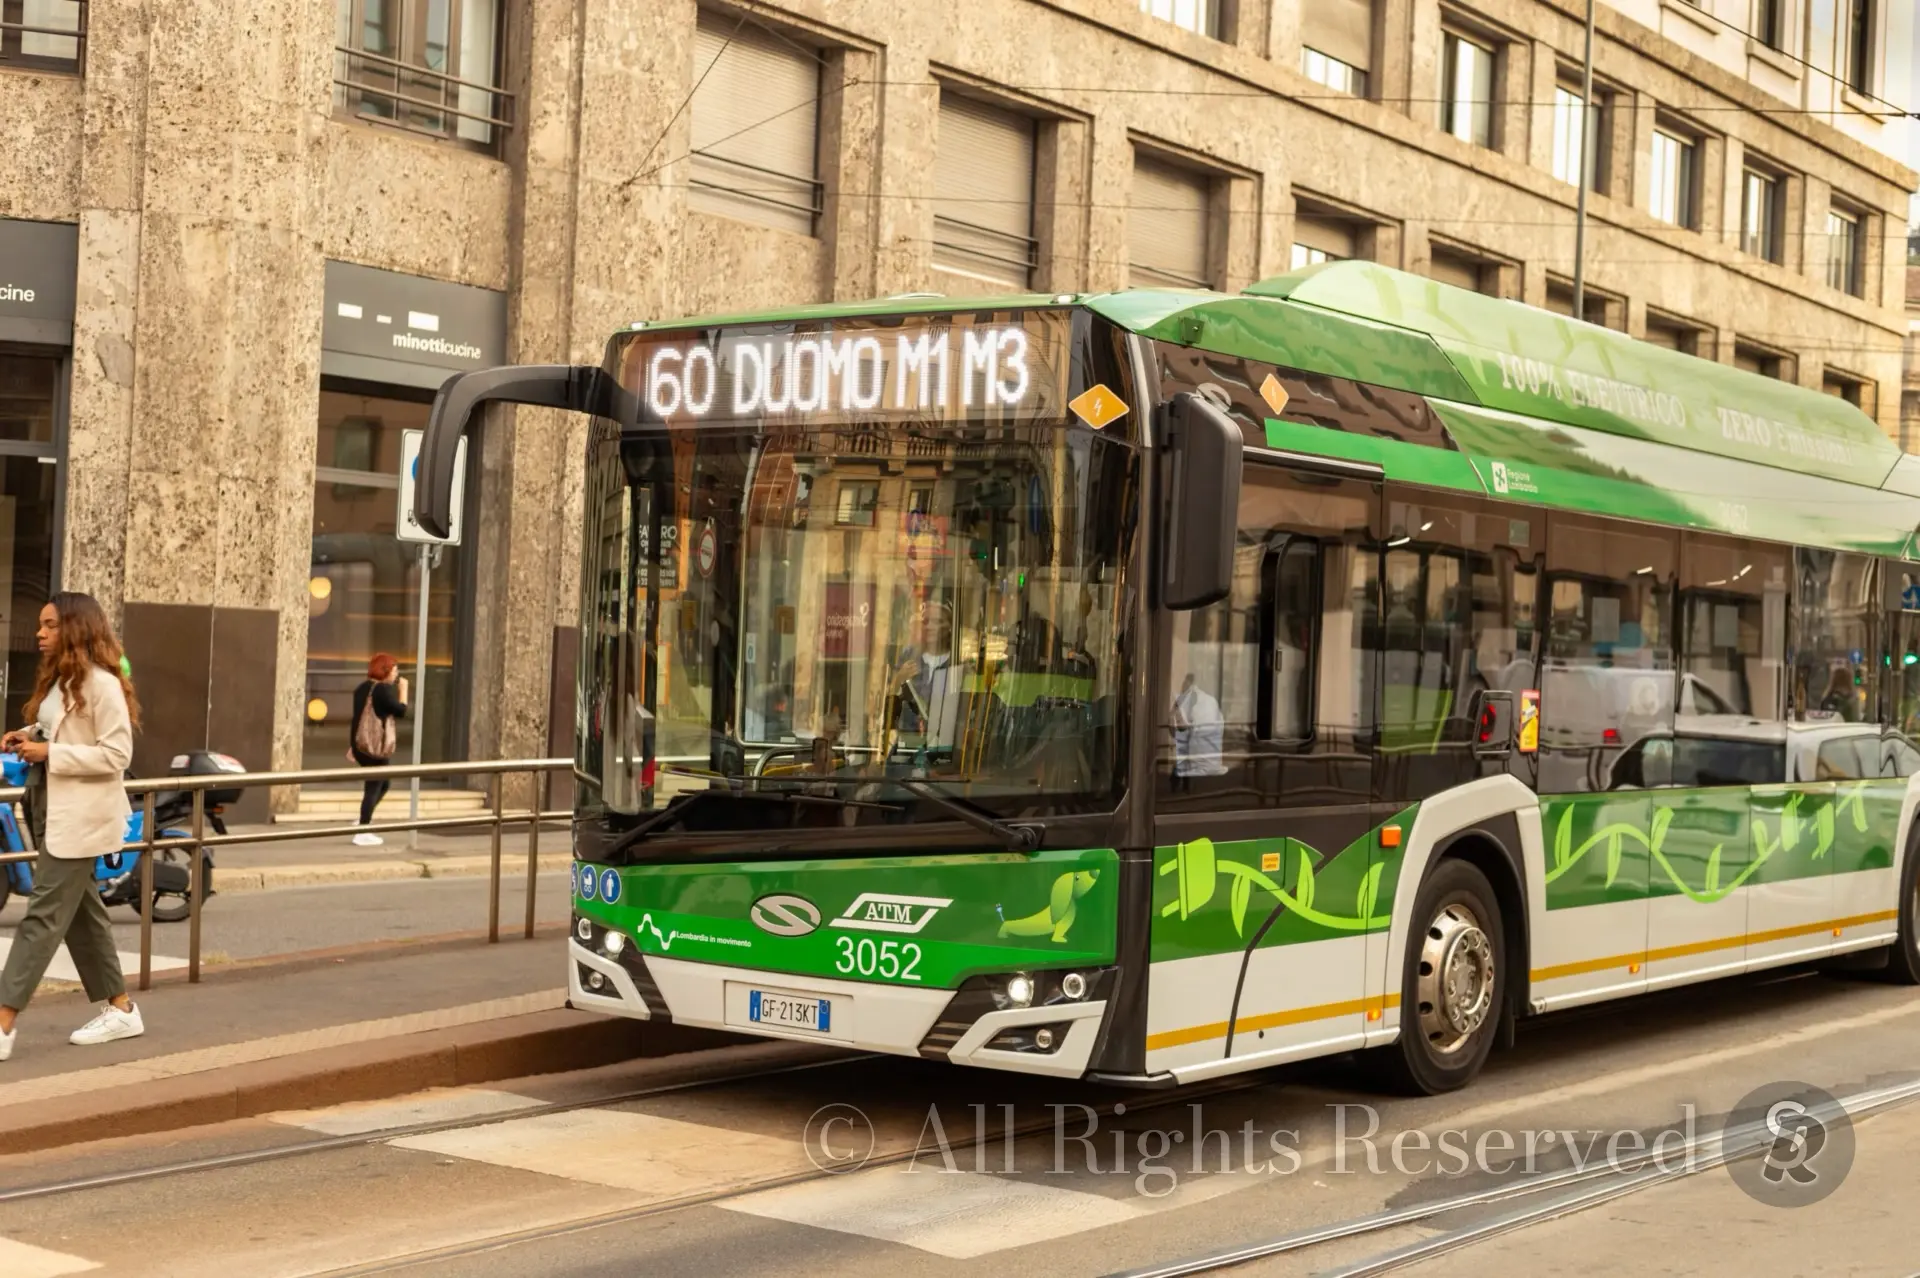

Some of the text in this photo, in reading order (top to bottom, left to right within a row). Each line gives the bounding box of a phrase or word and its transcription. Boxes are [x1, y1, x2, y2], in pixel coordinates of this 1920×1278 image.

[393, 332, 481, 359] minotticucine
[650, 327, 1029, 417] 60 DUOMO M1 M3
[1498, 351, 1562, 400] 100%
[1566, 369, 1686, 427] ELETTRICO
[1716, 406, 1771, 448] ZERO
[864, 902, 913, 924] ATM
[676, 931, 709, 942] Lombardia
[716, 936, 752, 948] movimento
[835, 936, 922, 981] 3052
